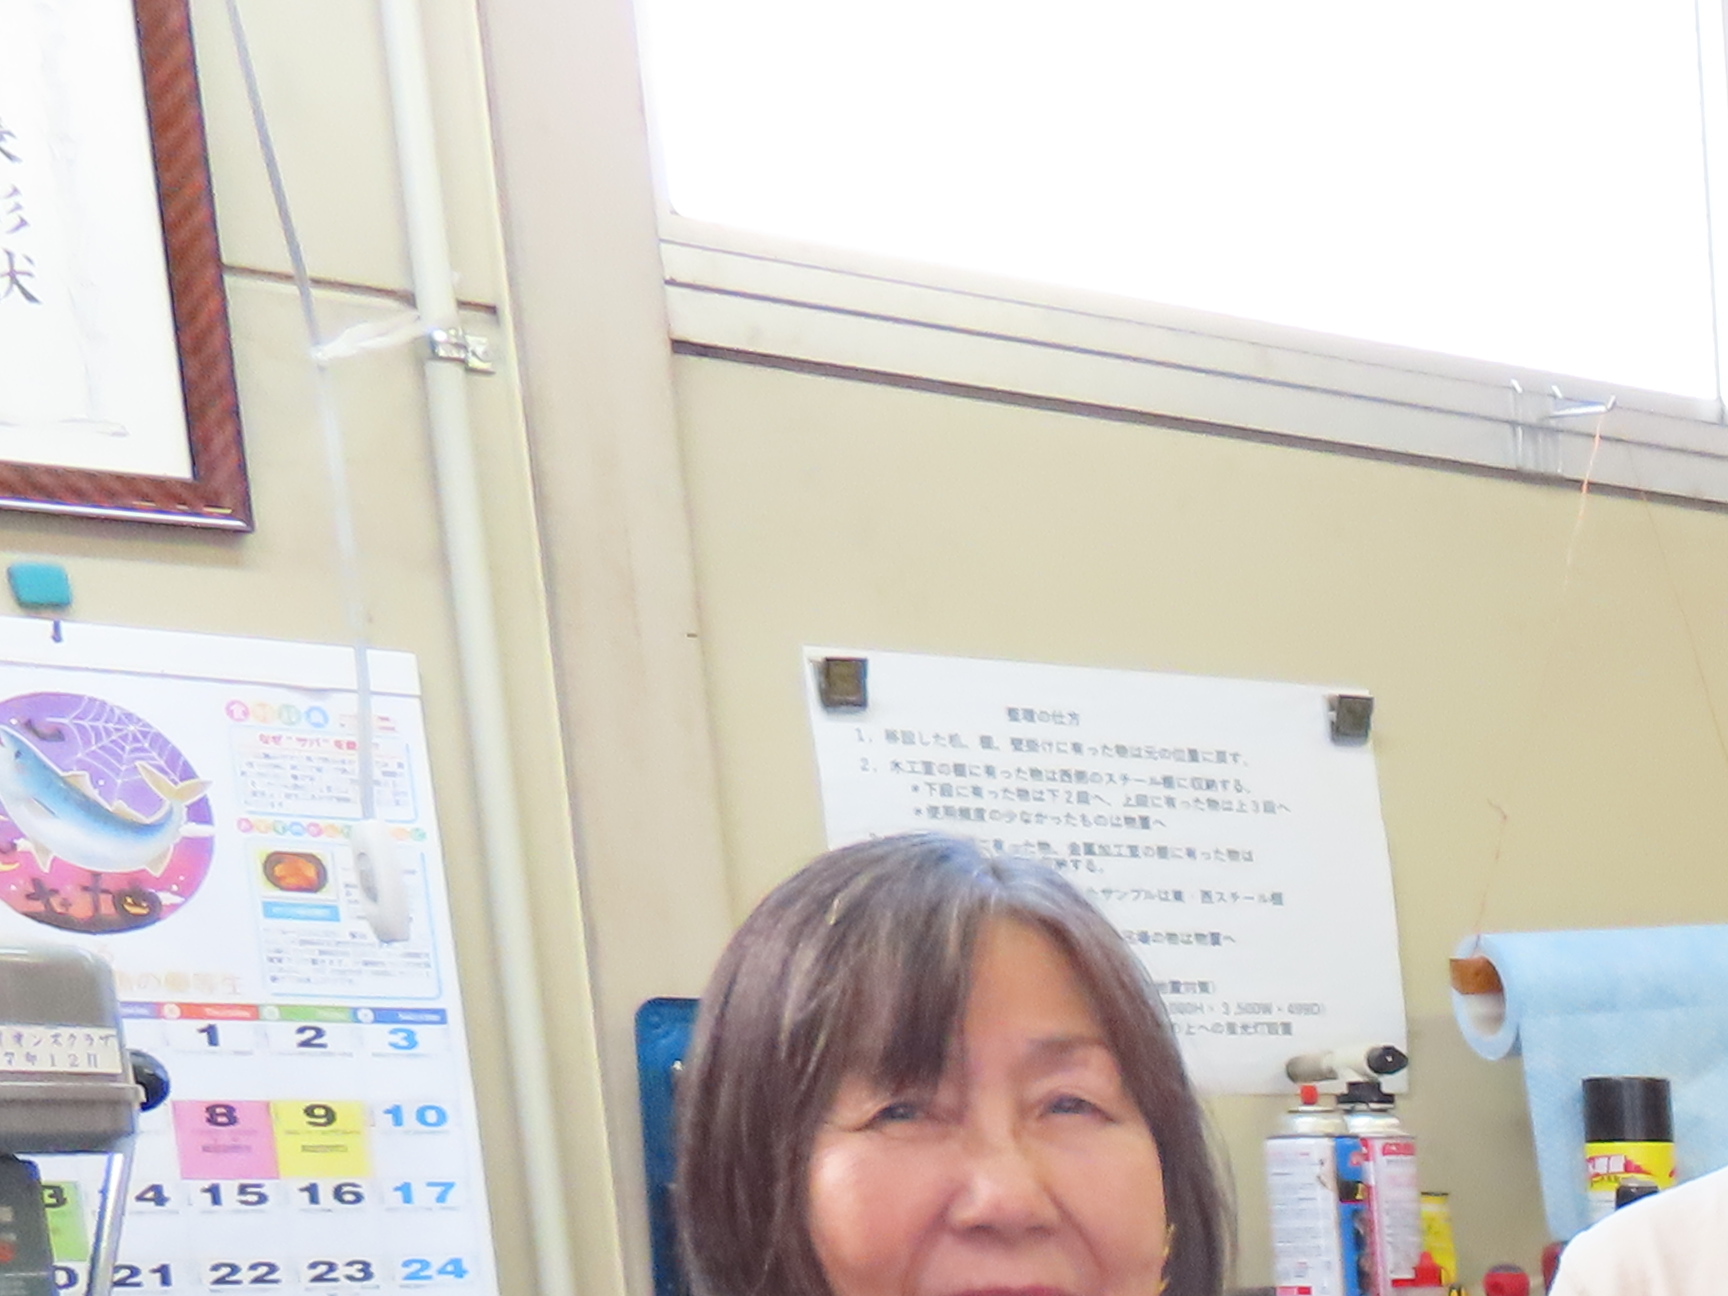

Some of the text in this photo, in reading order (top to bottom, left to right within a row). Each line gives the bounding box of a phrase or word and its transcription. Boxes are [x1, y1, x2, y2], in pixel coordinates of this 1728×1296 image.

[197, 1024, 419, 1050] 1 2 3
[205, 1103, 449, 1128] 8 9 10
[41, 1184, 68, 1208] 3
[200, 1183, 269, 1206] 15
[298, 1182, 365, 1206] 16
[394, 1181, 456, 1204] 17
[52, 1257, 469, 1290] 0 21 22 23 24
